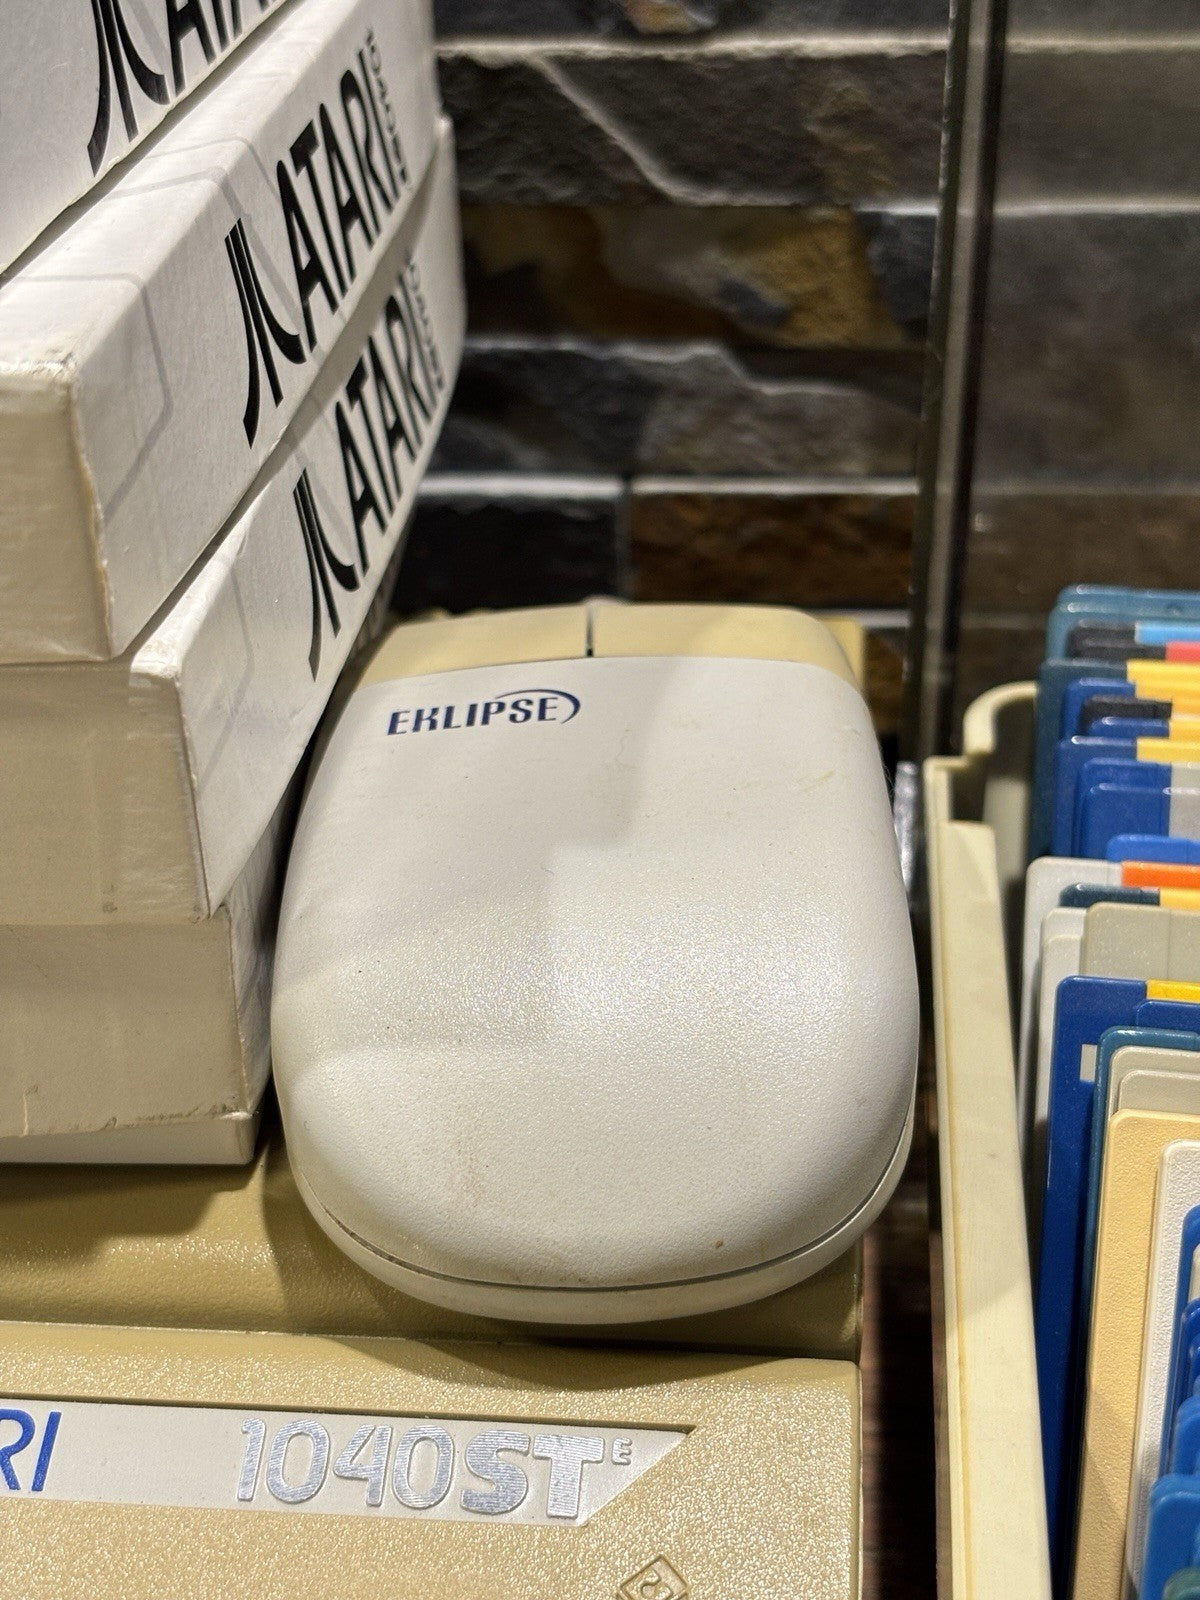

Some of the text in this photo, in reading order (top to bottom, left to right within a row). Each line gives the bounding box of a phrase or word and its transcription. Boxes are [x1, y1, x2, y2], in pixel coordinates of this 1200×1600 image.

[276, 48, 400, 354] ATARI
[335, 273, 438, 578] ATARI
[386, 696, 559, 736] EKLIPSE
